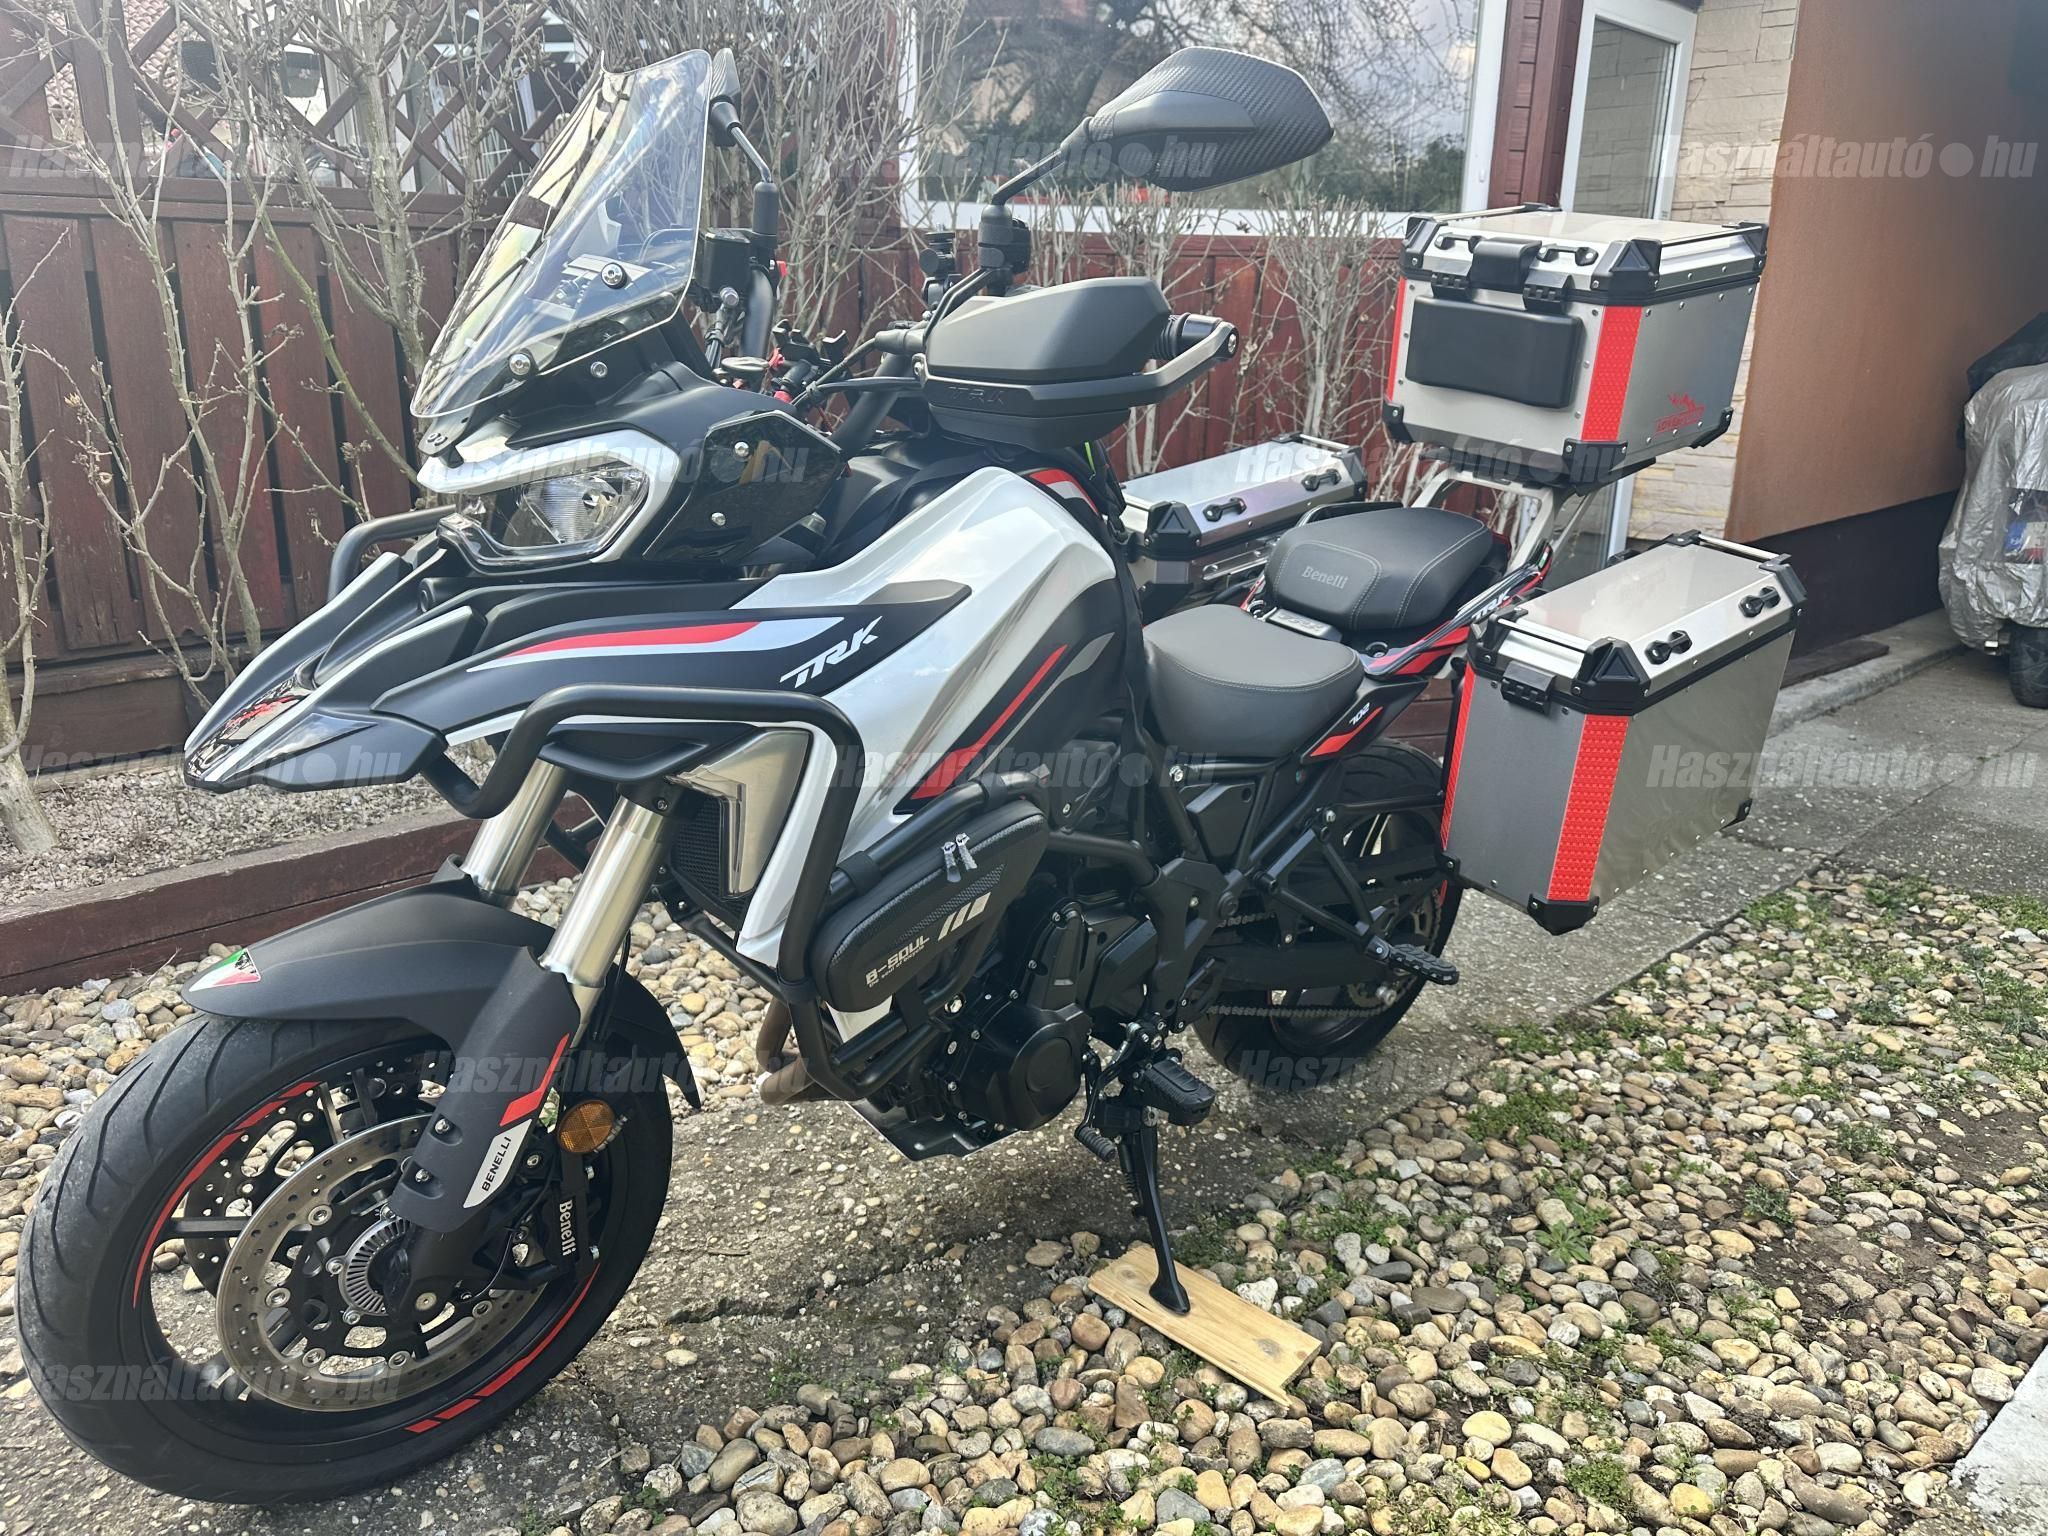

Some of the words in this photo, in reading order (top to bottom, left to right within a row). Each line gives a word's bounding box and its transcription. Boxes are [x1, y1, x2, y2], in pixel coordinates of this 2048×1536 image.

[1302, 566, 1350, 589] Benelli
[1471, 587, 1512, 621] TRK
[779, 615, 883, 689] TRK
[1349, 702, 1370, 725] 702
[865, 935, 930, 985] B-SOUL
[481, 1136, 512, 1192] BENELLI
[559, 1199, 577, 1256] Benelli
